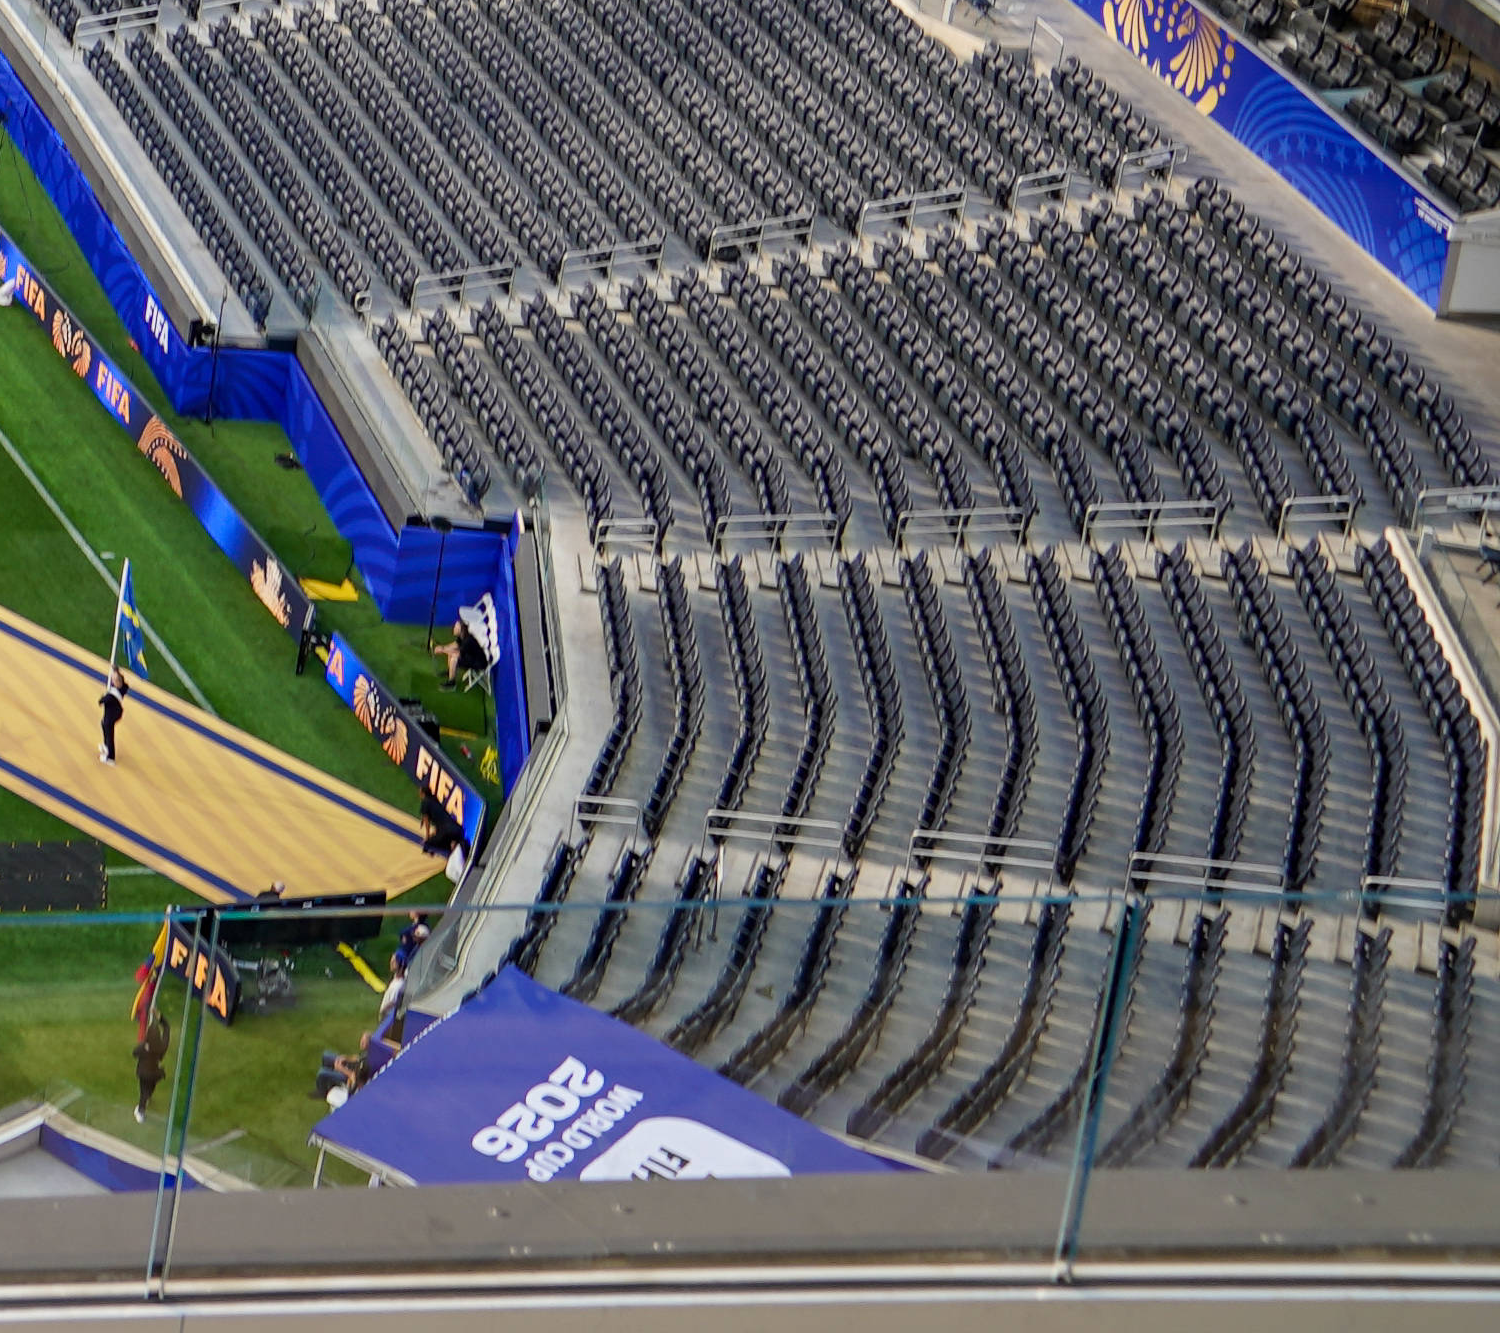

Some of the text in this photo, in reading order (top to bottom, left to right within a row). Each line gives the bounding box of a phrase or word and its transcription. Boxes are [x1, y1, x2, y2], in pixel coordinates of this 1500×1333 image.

[16, 266, 44, 320] FIFA
[145, 295, 168, 353] FIFA
[97, 361, 129, 423] FIFA
[418, 747, 463, 825] FIFA
[472, 1055, 604, 1163] 2026
[562, 1084, 644, 1150] WORLD
